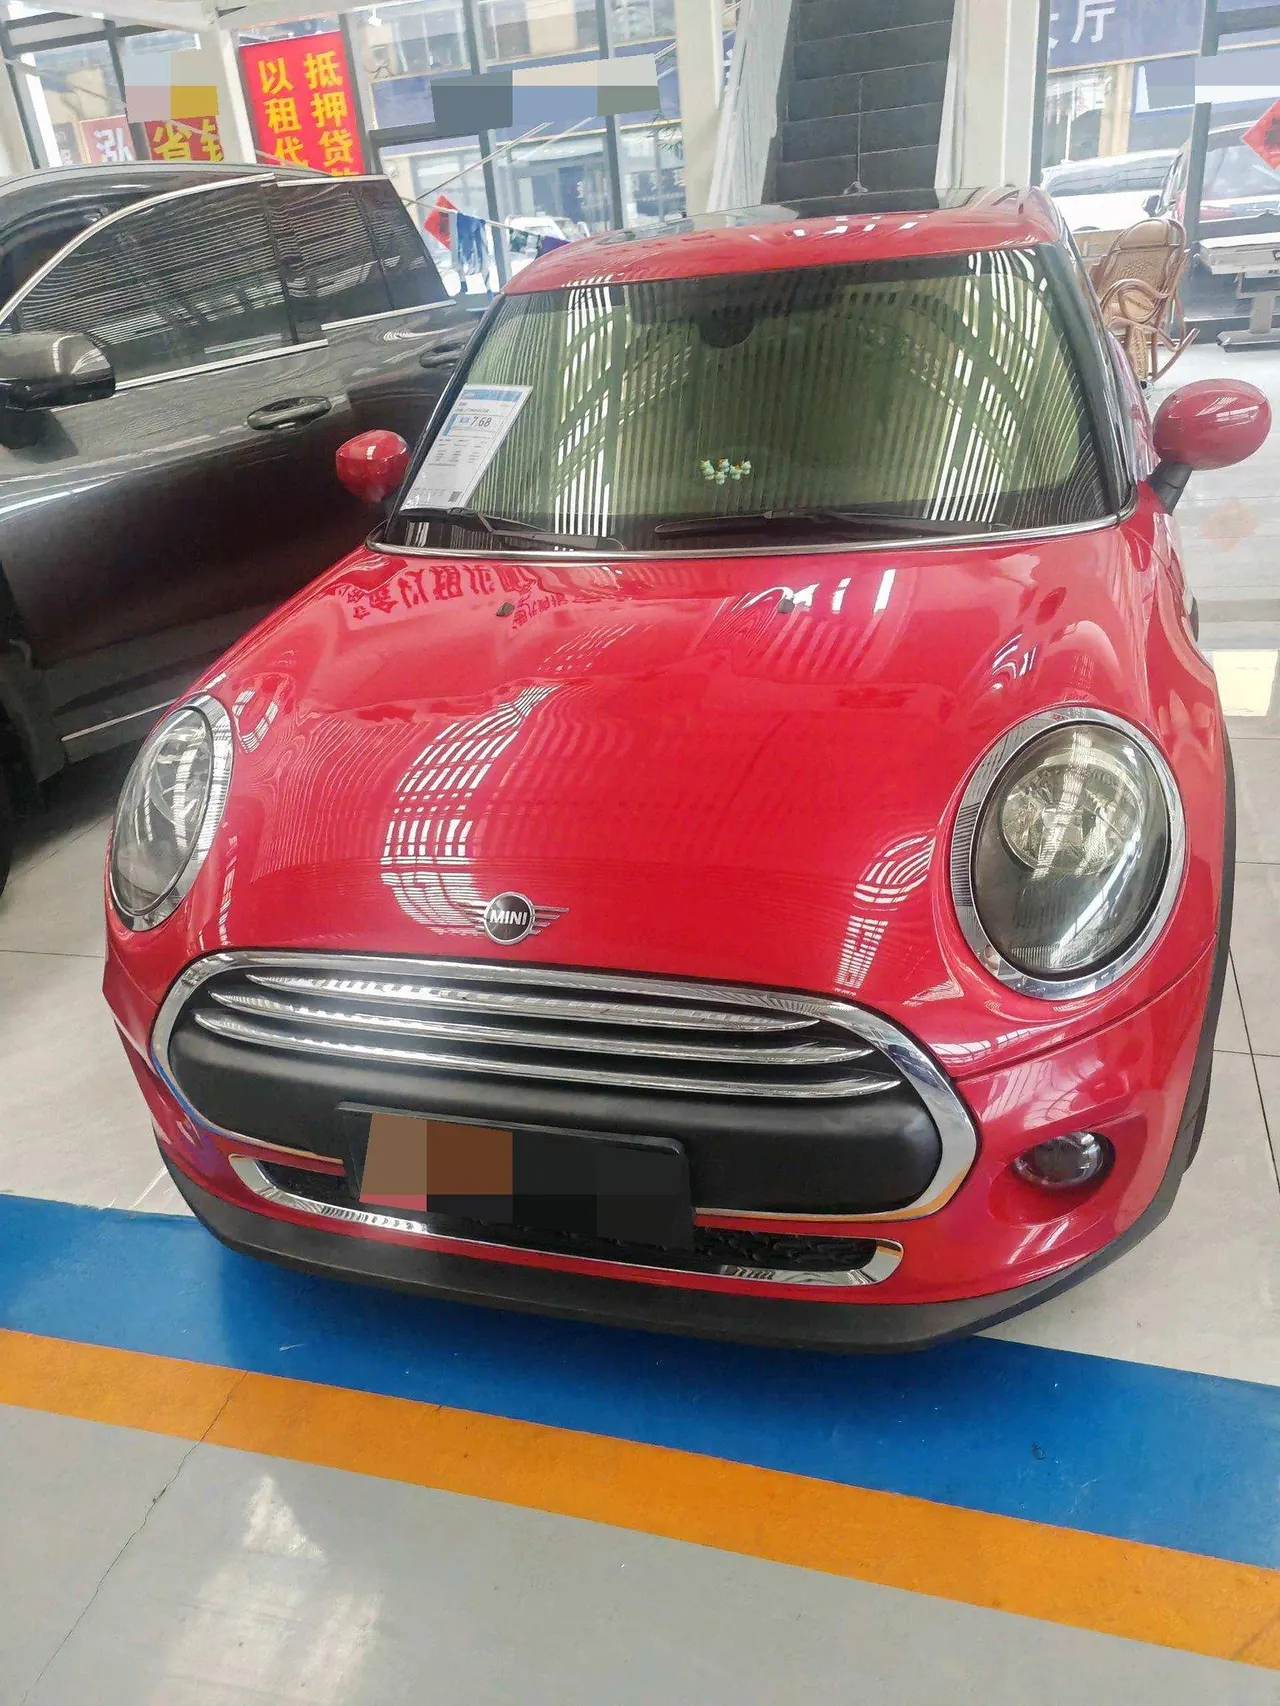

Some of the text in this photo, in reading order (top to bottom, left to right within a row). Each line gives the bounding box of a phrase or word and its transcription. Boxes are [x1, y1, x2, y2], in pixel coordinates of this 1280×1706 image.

[1048, 0, 1116, 49] 厅
[258, 57, 309, 169] 以租代
[303, 50, 359, 176] 抵押贷
[470, 416, 493, 428] 7.68
[490, 909, 528, 926] MINI
